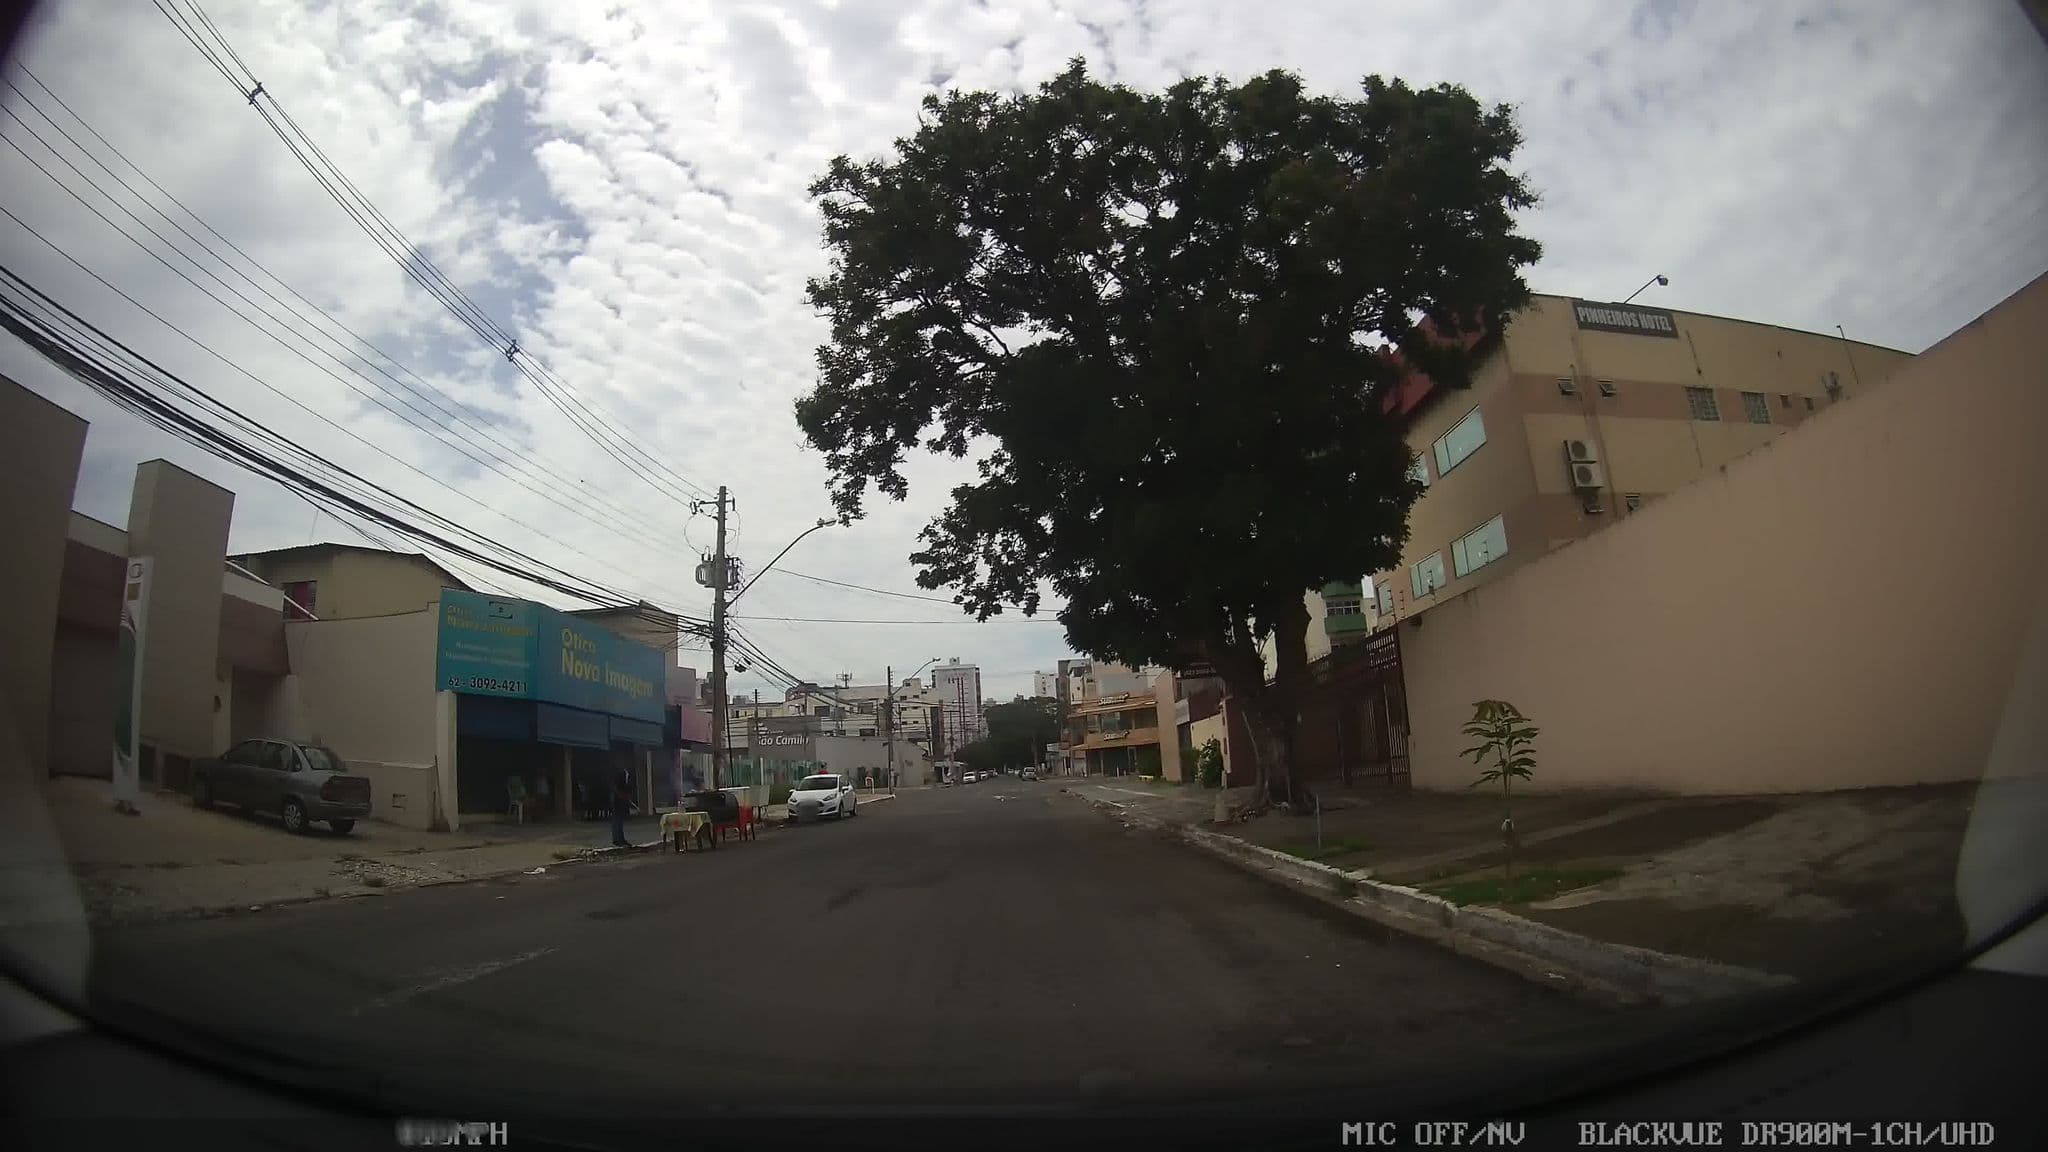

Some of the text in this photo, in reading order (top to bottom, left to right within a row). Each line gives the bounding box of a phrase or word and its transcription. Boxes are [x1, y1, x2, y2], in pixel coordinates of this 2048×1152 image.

[1577, 306, 1673, 332] PINHEIROS HOTEL
[470, 676, 527, 692] 3092-4211
